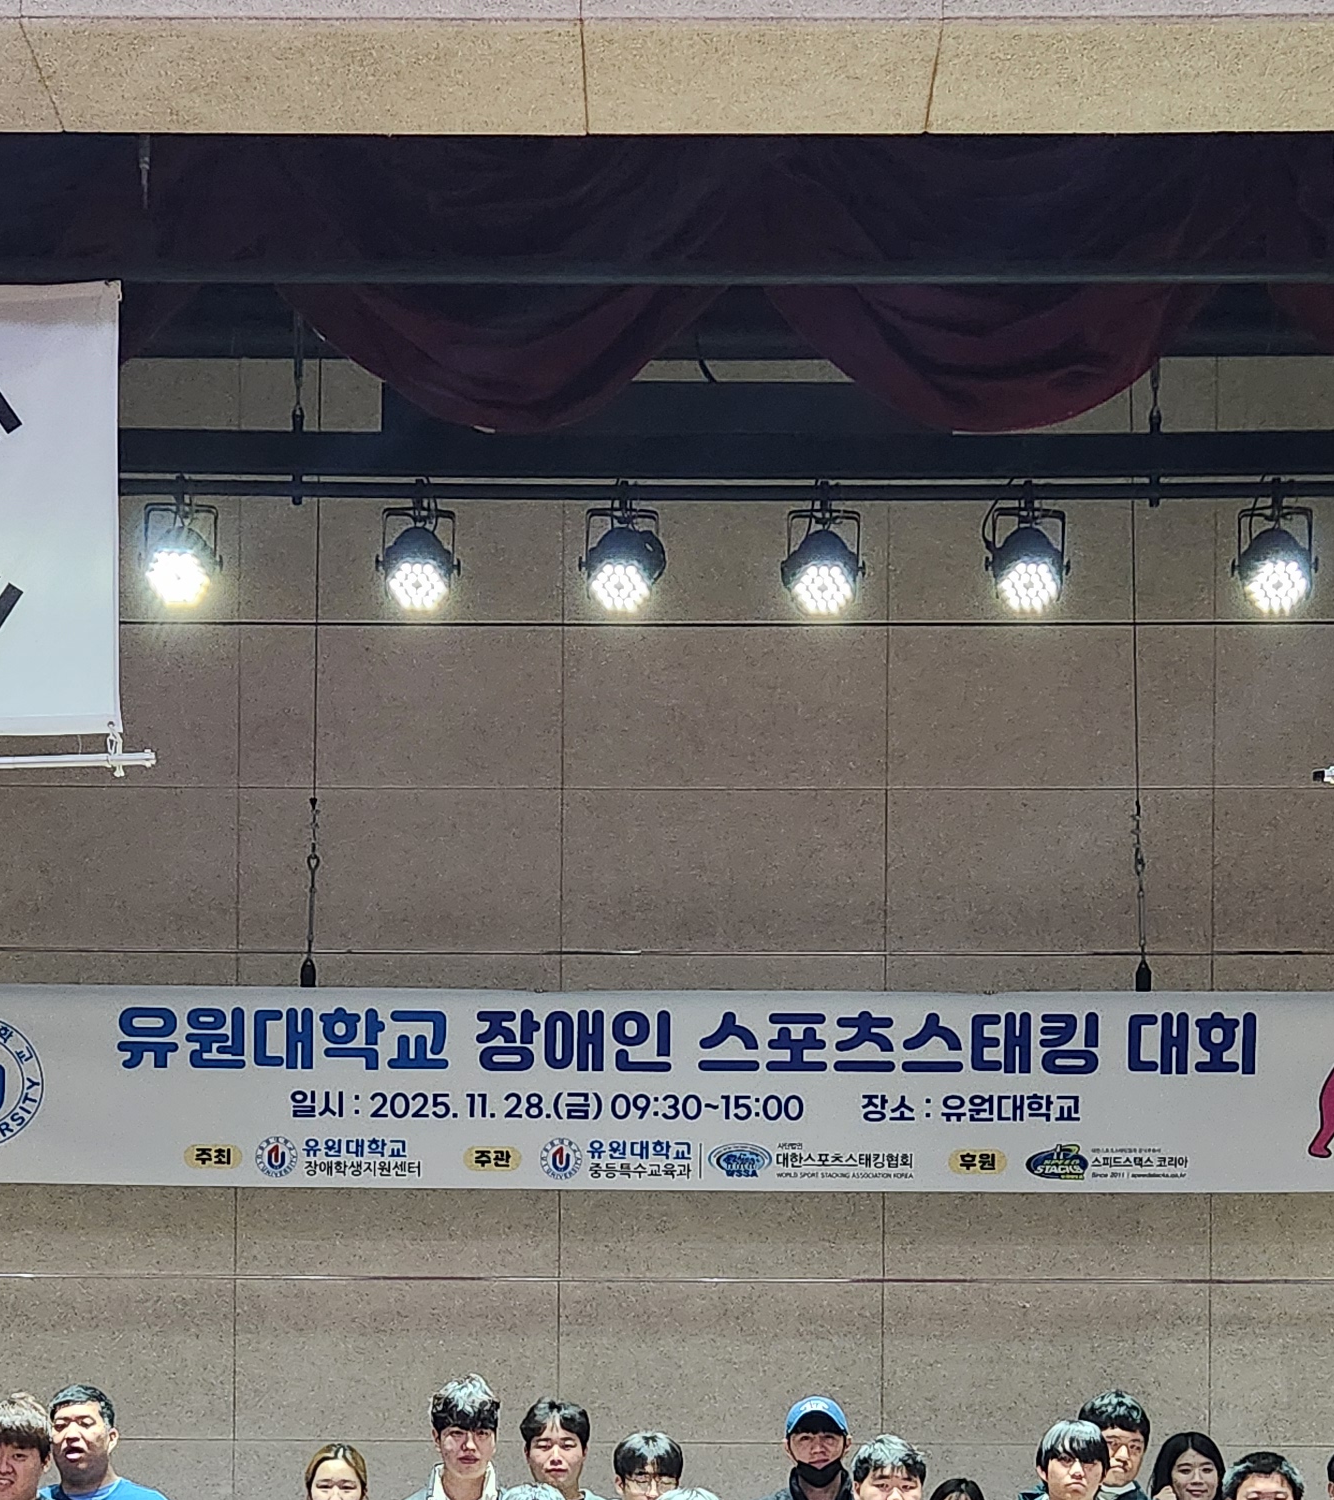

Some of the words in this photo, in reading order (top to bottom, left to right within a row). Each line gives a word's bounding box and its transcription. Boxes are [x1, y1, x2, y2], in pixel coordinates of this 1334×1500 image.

[117, 1006, 449, 1071] 유원대학교
[476, 1009, 672, 1073] 장애인
[698, 1010, 1103, 1075] 스포츠스태킹
[1128, 1011, 1258, 1076] 대회
[290, 1089, 344, 1118] 일시
[369, 1091, 459, 1119] 2025.
[465, 1093, 496, 1119] 11.
[503, 1091, 603, 1121] 28.(금)
[610, 1093, 804, 1121] 09:30~15:00
[861, 1094, 916, 1123] 장소
[940, 1093, 1081, 1123] 유원대학교
[194, 1147, 231, 1166] 주최
[302, 1137, 408, 1158] 유원대학교
[586, 1139, 693, 1161] 유원대학교
[474, 1150, 511, 1168] 주관
[775, 1152, 914, 1169] 대한스포츠스태킹협회
[959, 1152, 996, 1171] 후원
[1090, 1156, 1154, 1169] 스피드스택스
[1155, 1156, 1189, 1169] 코리아
[304, 1160, 421, 1178] 장애학생지원센터
[588, 1162, 692, 1180] 중등특수교육과
